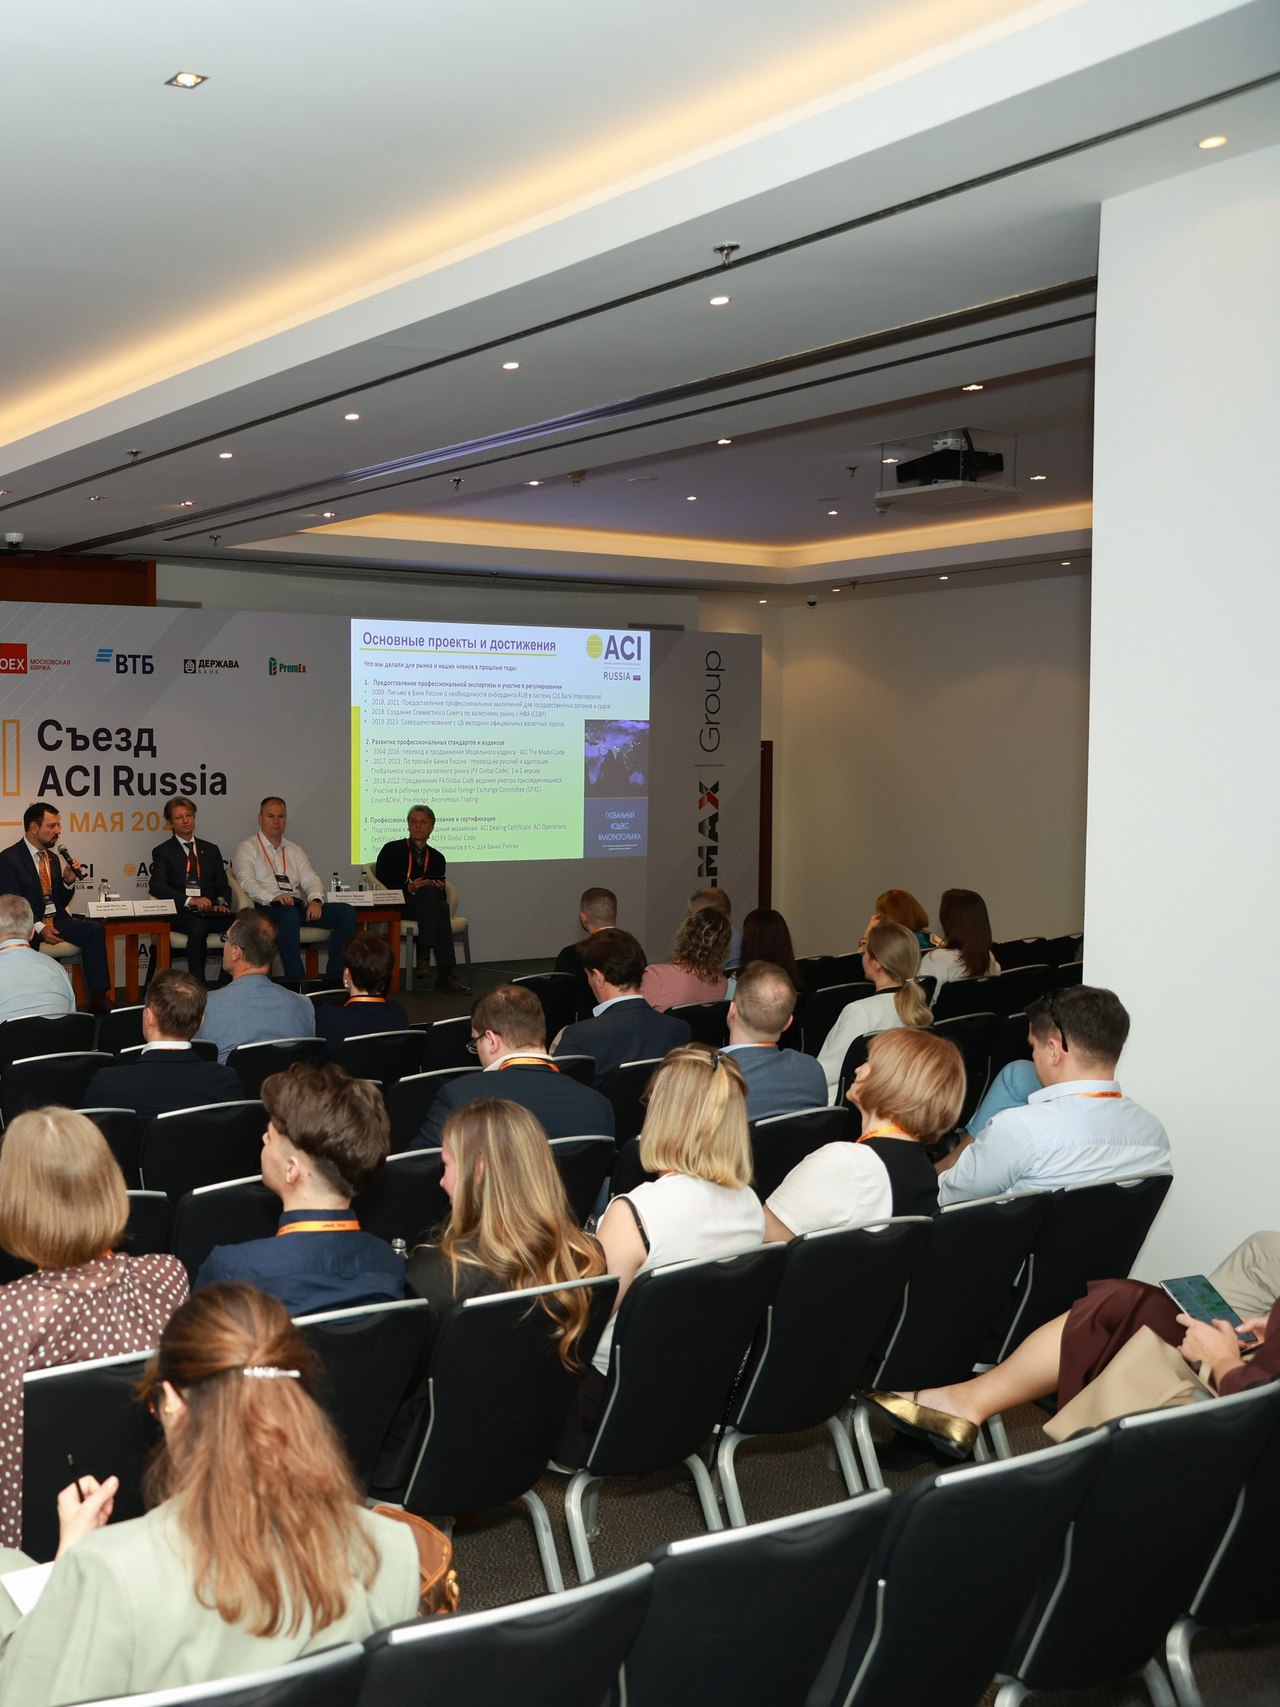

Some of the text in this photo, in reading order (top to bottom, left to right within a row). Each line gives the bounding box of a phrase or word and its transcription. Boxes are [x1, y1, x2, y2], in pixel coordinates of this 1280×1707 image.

[363, 632, 556, 653] Основные проекты и достижения
[604, 635, 642, 661] ACI
[116, 654, 154, 674] ВТБ
[198, 659, 240, 669] ДЕРЖАВА
[279, 663, 307, 674] PremEx
[604, 671, 631, 681] RUSSIA
[699, 650, 725, 753] Group
[37, 719, 157, 758] Съезд
[37, 764, 228, 797] ACI Russia
[71, 812, 124, 832] МАЯ
